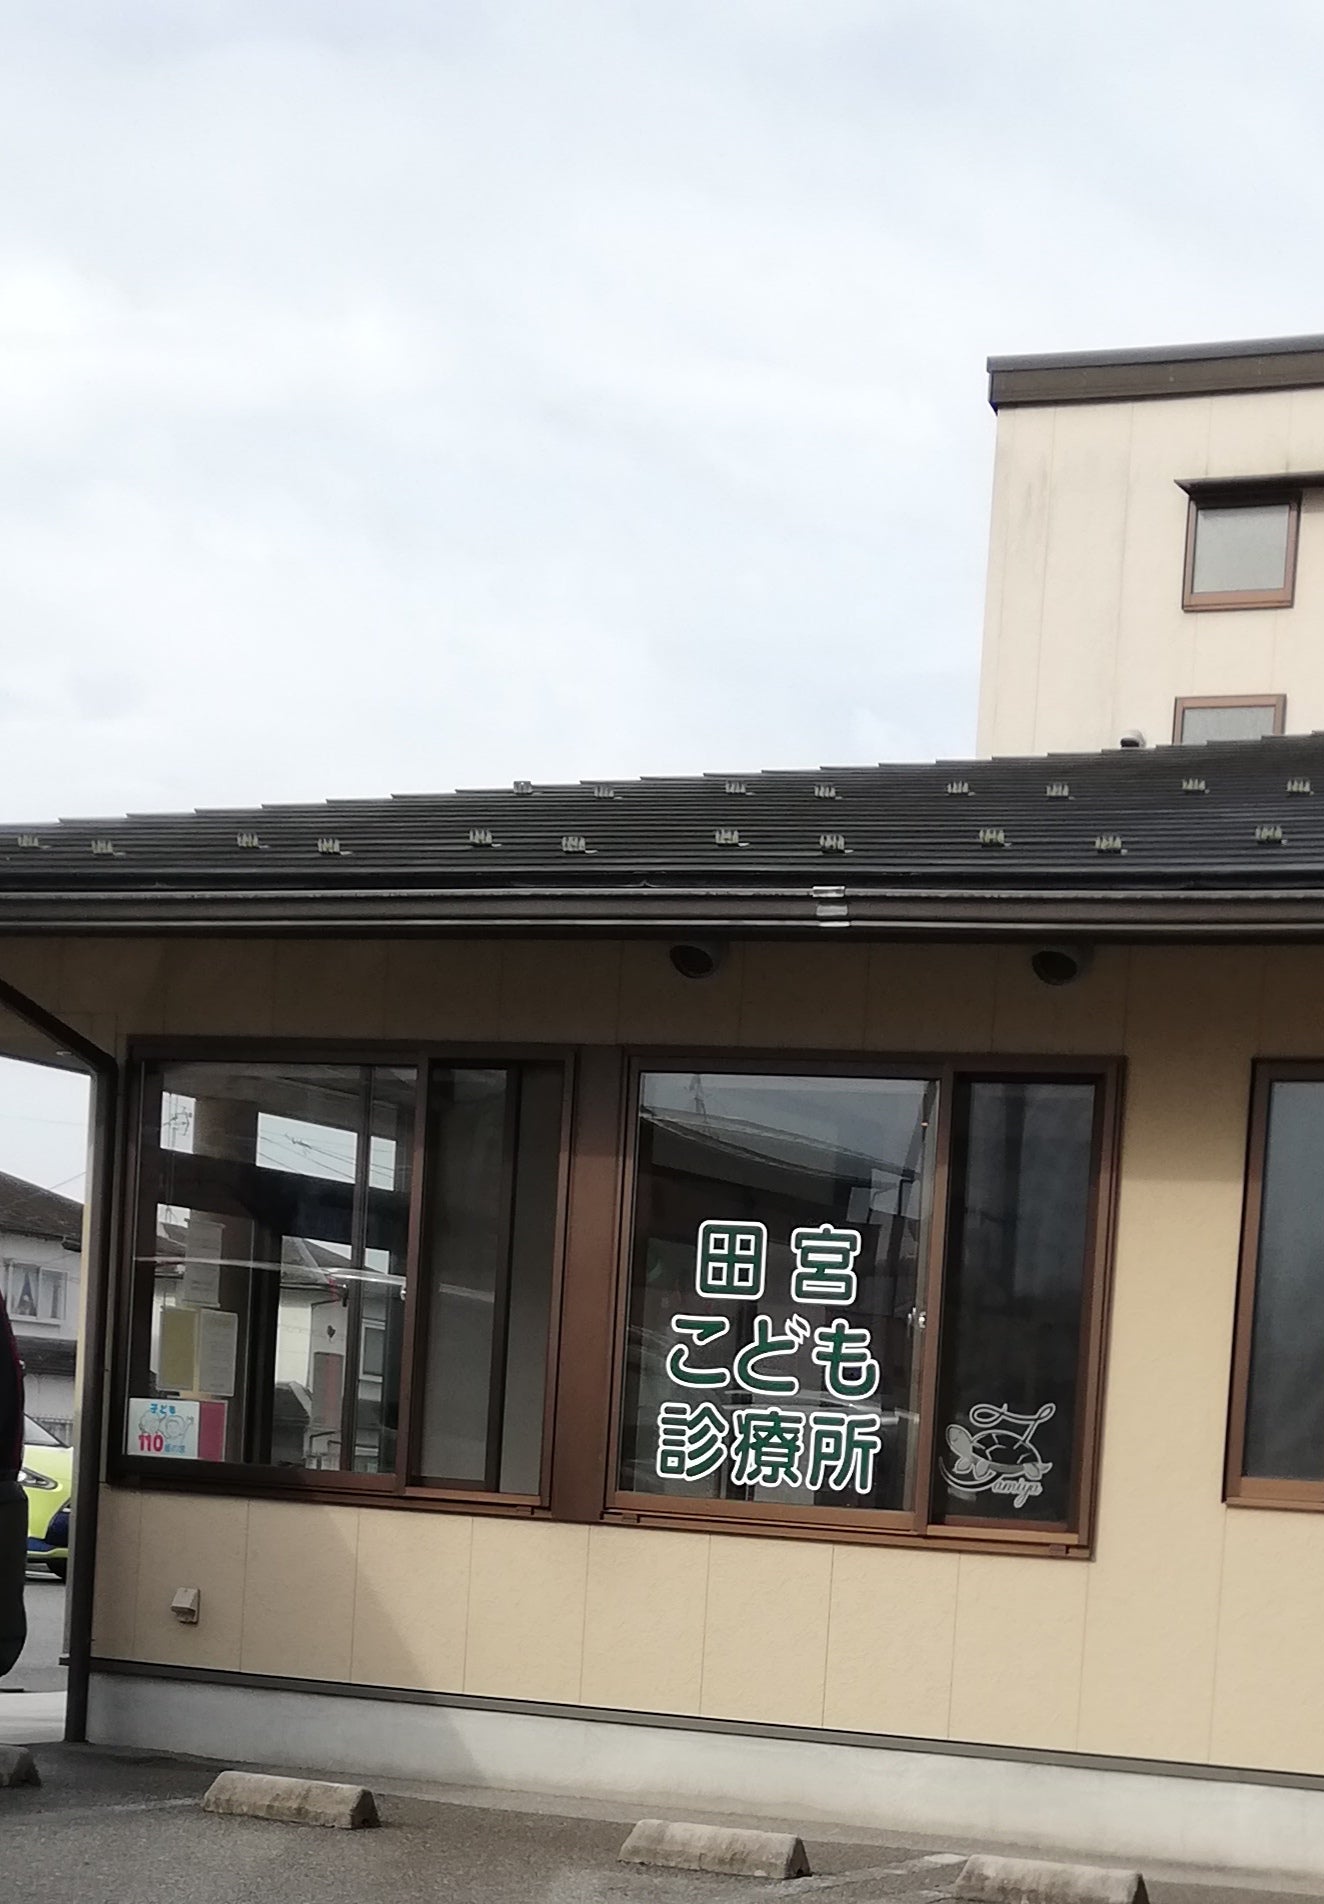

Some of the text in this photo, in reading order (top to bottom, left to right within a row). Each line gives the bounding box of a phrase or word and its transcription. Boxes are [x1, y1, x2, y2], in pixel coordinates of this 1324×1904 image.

[667, 1314, 880, 1400] こども
[656, 1402, 882, 1494] 診療所
